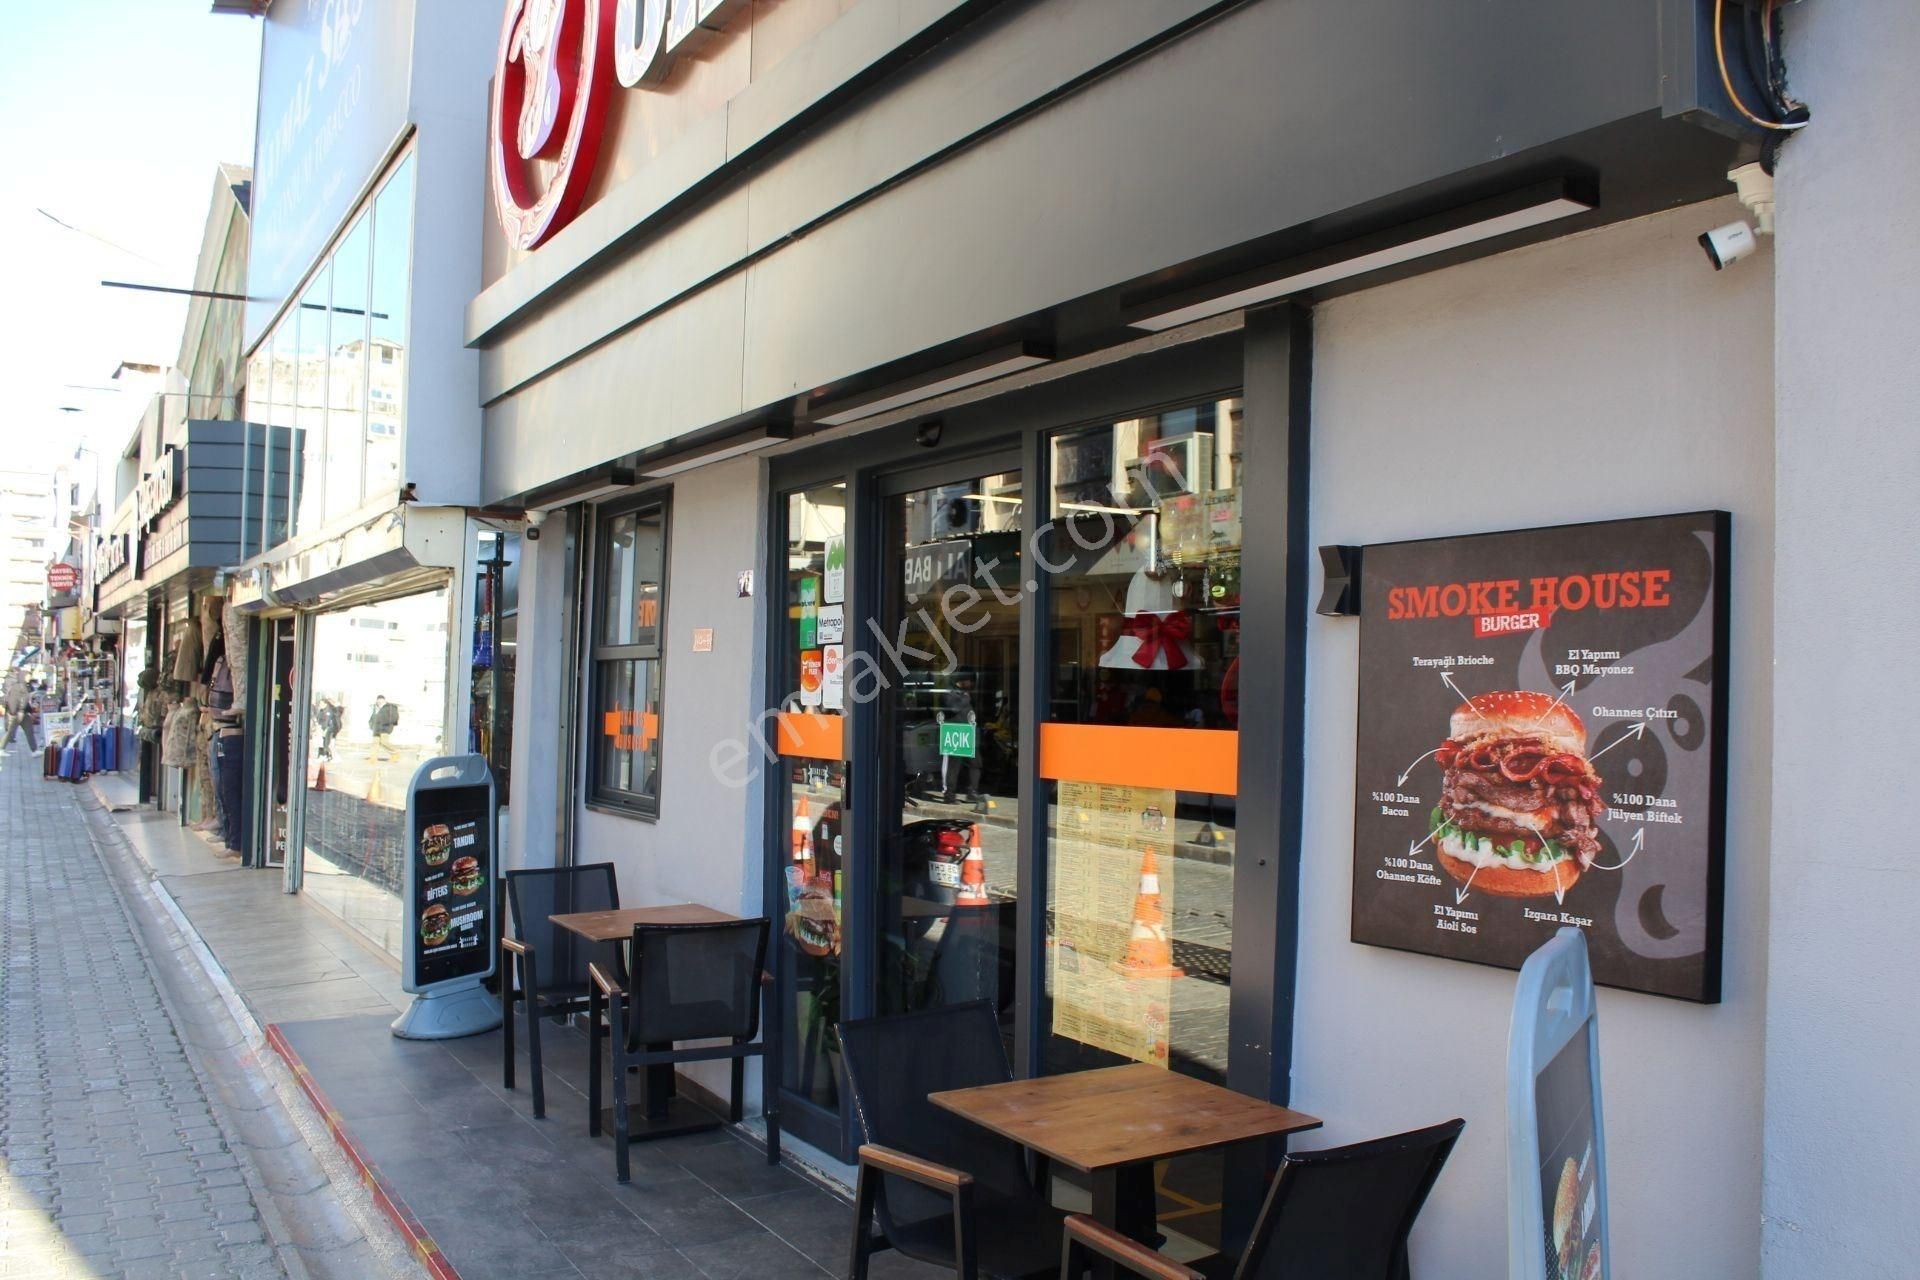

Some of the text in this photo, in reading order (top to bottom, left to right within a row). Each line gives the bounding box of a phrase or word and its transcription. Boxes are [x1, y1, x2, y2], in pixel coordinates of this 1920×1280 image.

[1388, 569, 1671, 620] SMOKE HOUSE
[1481, 613, 1540, 633] BURGER
[1457, 655, 1495, 666] Brioche
[1568, 649, 1620, 662] El Yapımı
[1555, 664, 1634, 677] BBQ Mayonez
[1592, 706, 1643, 718] Ohannes
[945, 731, 970, 748] AÇIK
[1372, 791, 1420, 804] %100 Dana
[1613, 792, 1677, 808] %100 Dana
[1381, 805, 1409, 817] Bacon
[1607, 807, 1682, 824] Jülyen Biftek
[1384, 857, 1433, 871] %100 Dana
[1376, 869, 1442, 886] Ohannes Köfte
[1433, 904, 1479, 921] El Yapımı
[1523, 907, 1593, 928] Izgara Kaşar
[1436, 918, 1478, 934] Aioli Sos
